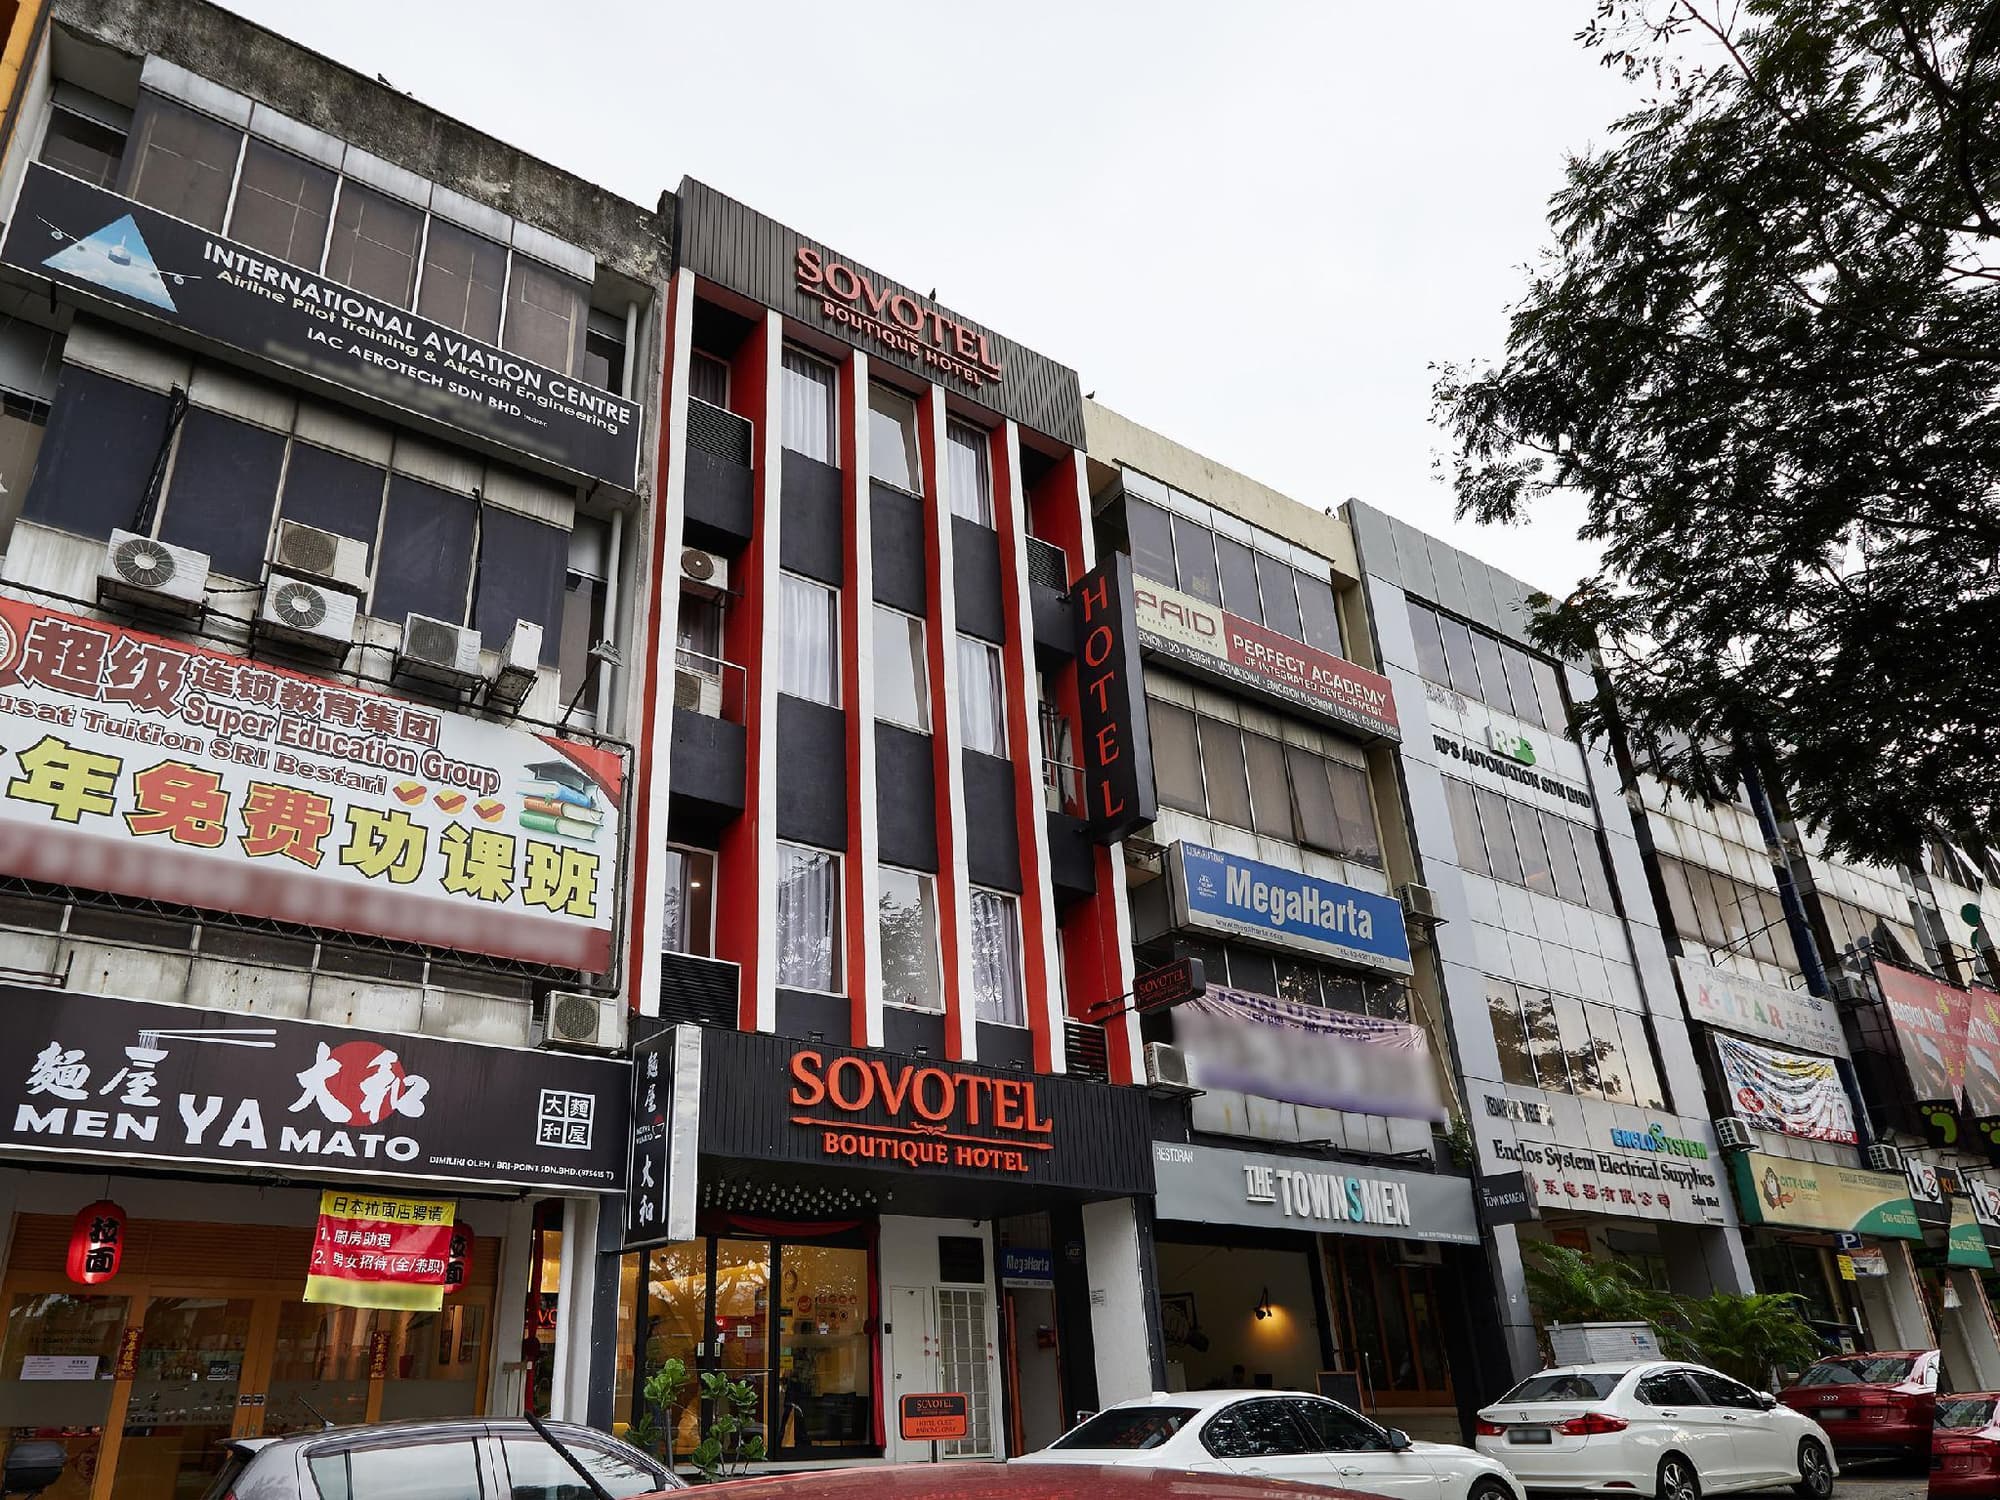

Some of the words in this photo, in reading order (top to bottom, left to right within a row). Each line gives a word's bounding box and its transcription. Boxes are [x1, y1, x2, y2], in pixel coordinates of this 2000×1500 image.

[204, 241, 415, 341] INTERNATIONAL
[423, 331, 541, 390] AVIATION
[548, 380, 630, 424] CENTRE
[796, 247, 1002, 372] SOVOTEL
[216, 270, 286, 304] Airline
[292, 298, 336, 323] Pilot
[340, 316, 419, 357] Training
[424, 351, 437, 363] &
[443, 358, 512, 391] Aircraft
[516, 386, 619, 435] Engineering
[306, 327, 343, 350] IAC
[348, 344, 444, 388] AEROTECH
[448, 381, 482, 403] SDN
[488, 395, 522, 417] BHD
[822, 299, 920, 359] BOUTIQUE
[925, 350, 983, 388] HOTEL
[16, 617, 190, 719] 超级
[189, 655, 442, 748] 连锁教育集团
[1081, 576, 1124, 818] HOTEL
[1233, 633, 1306, 675] PERFECT
[1311, 665, 1386, 707] ACADEMY
[1244, 656, 1257, 667] OF
[1259, 661, 1318, 691] INTEGRATED
[80, 707, 204, 754] Tuition
[209, 737, 271, 769] SRI
[273, 751, 388, 795] Bestari
[182, 691, 277, 741] Super
[275, 711, 418, 777] Education
[420, 749, 501, 797] Group
[1462, 745, 1541, 790] AUTOMATION
[1541, 776, 1567, 800] SDN
[1566, 786, 1592, 808] BHD
[0, 733, 601, 919] 年免费功课班
[1225, 864, 1374, 941] MegaHarta
[1138, 967, 1185, 994] SOVOTEL
[287, 1040, 431, 1124] 大和
[789, 1050, 1053, 1133] SOVOTEL
[12, 1103, 161, 1142] MEN
[177, 1093, 268, 1150] YA
[279, 1126, 421, 1163] MATO
[541, 1095, 564, 1141] 大和
[429, 1155, 466, 1168] DIMILIKI
[823, 1132, 949, 1168] BOUTIQUE
[954, 1145, 1029, 1172] HOTEL
[1155, 1147, 1193, 1164] RESTORAN
[1492, 1138, 1544, 1166] Enclos
[1546, 1147, 1596, 1173] System
[1596, 1153, 1661, 1181] Electrical
[1660, 1163, 1716, 1191] Supplies
[332, 1196, 444, 1222] 日本拉面店聘请
[1242, 1164, 1276, 1198] THE
[1275, 1168, 1412, 1227] TOWNSMEN
[1483, 1191, 1526, 1208] TOWNSMEN
[1691, 1193, 1706, 1206] Sdn
[1705, 1195, 1720, 1208] Bhd
[86, 1216, 119, 1273] 拉面
[314, 1249, 327, 1265] 2.
[332, 1252, 387, 1272] 男女招待
[390, 1257, 446, 1276] (全/兼职)
[320, 1227, 331, 1241] 1.
[333, 1229, 392, 1248] 厨房助理
[1006, 1254, 1050, 1273] MegaHarta
[1842, 1233, 1857, 1249] P
[916, 1399, 954, 1409] SOVOTEL
